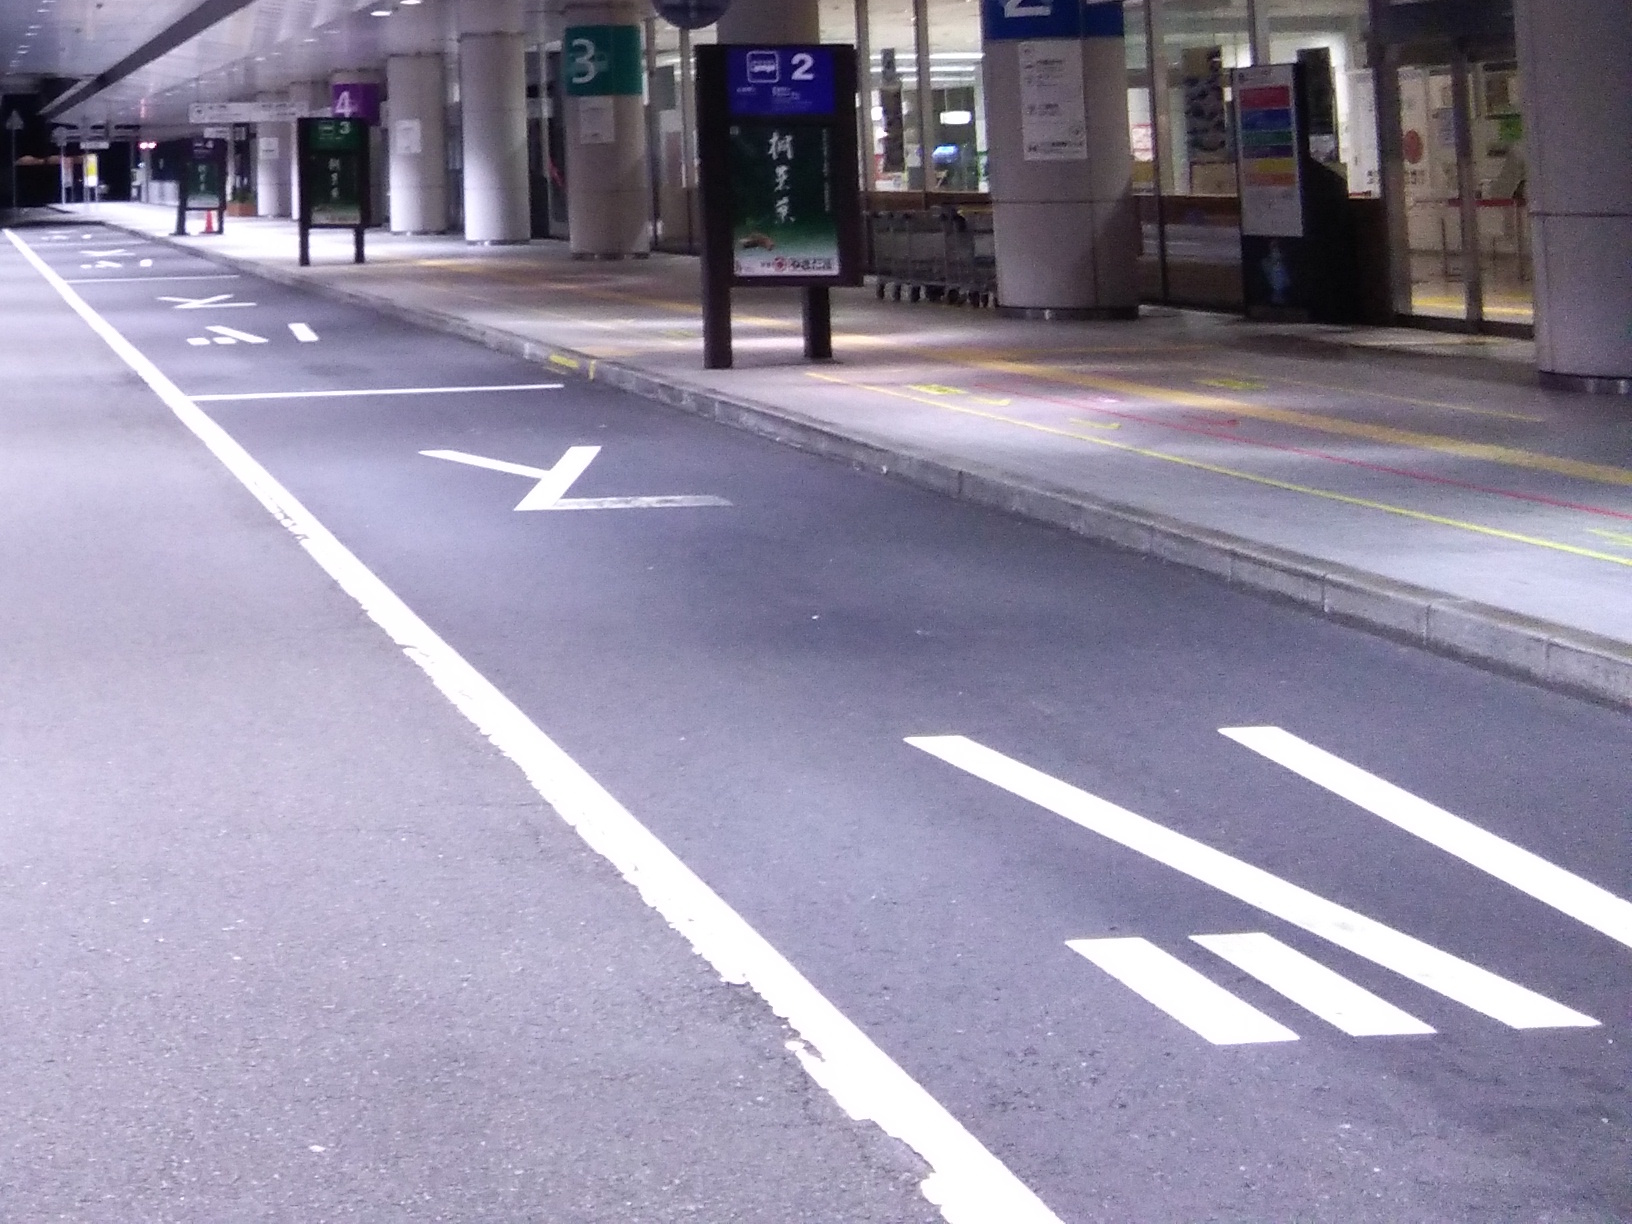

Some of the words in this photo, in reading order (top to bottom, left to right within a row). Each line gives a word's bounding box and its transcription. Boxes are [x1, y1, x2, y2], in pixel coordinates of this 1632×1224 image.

[571, 38, 598, 85] 3
[790, 52, 815, 81] 2
[335, 89, 354, 118] 4
[339, 121, 352, 135] 3
